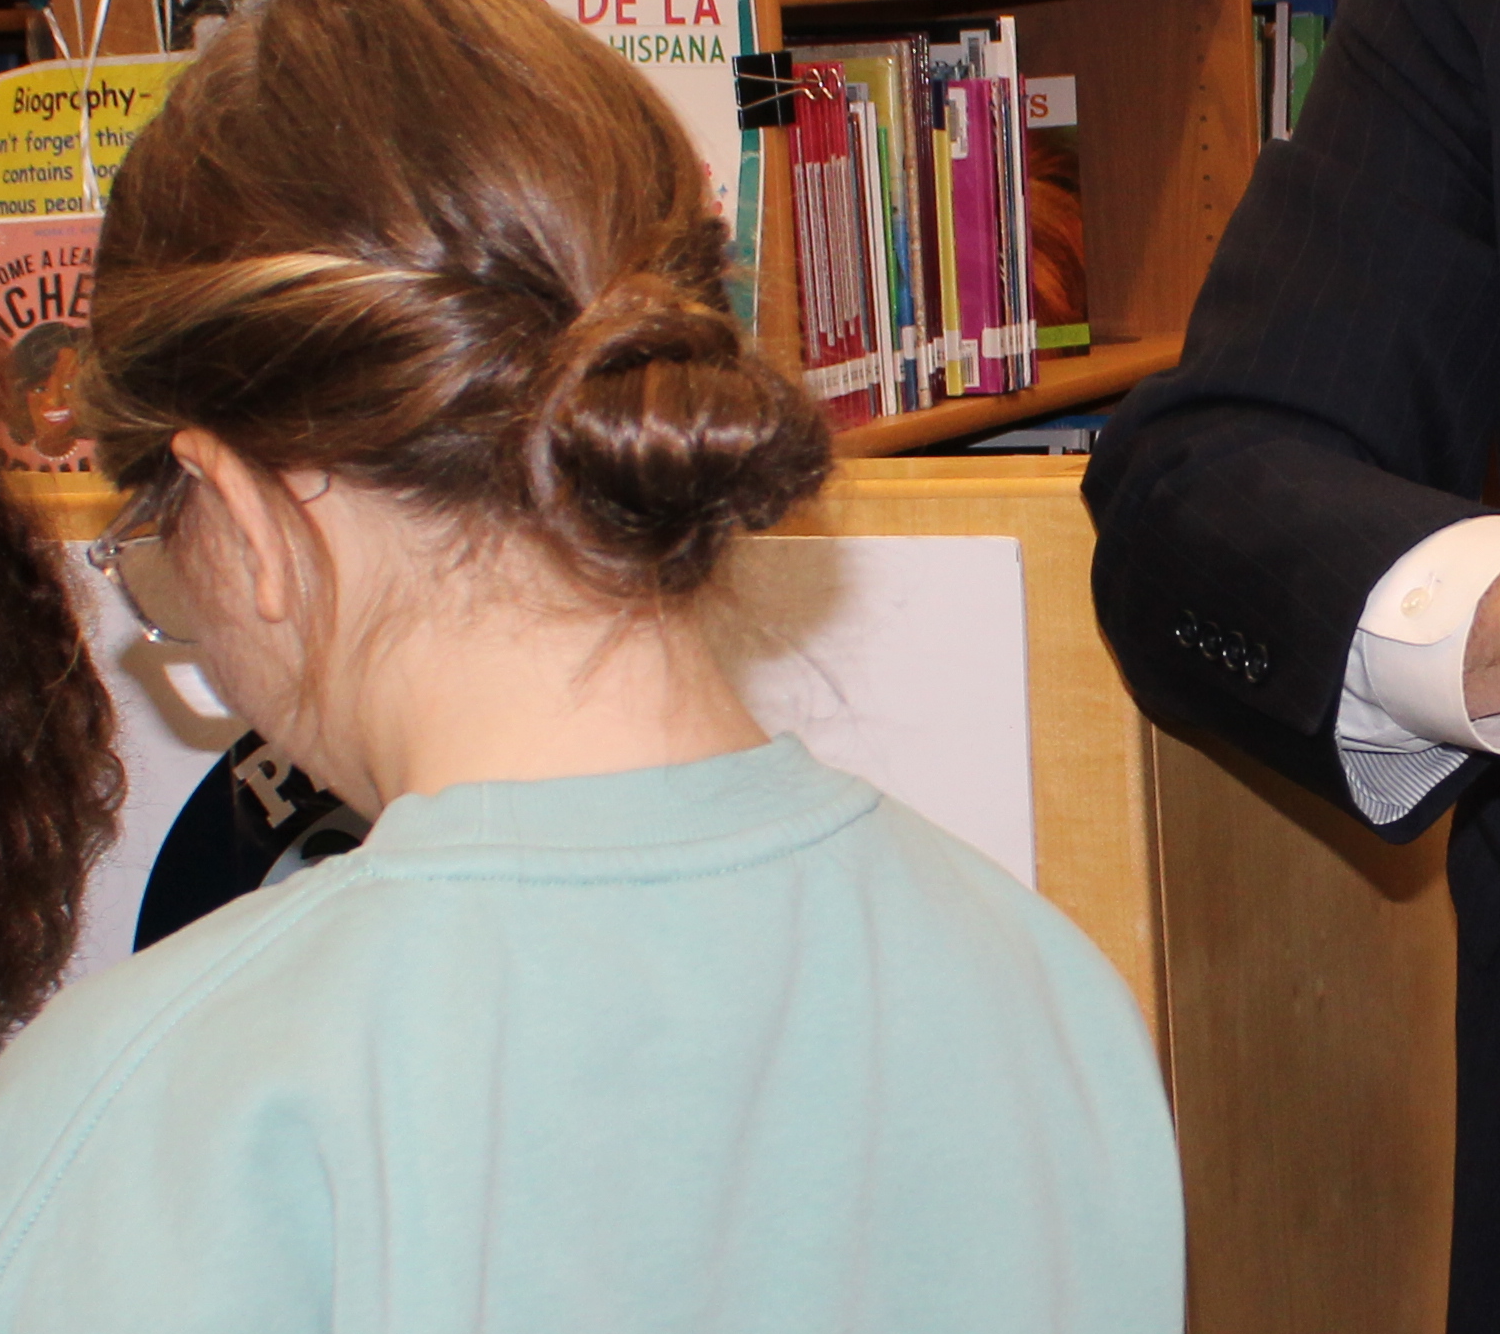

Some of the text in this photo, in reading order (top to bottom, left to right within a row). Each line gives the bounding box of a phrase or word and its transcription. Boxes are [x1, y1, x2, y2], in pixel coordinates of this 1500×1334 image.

[96, 126, 136, 148] this
[2, 161, 74, 184] contains
[42, 249, 54, 268] A
